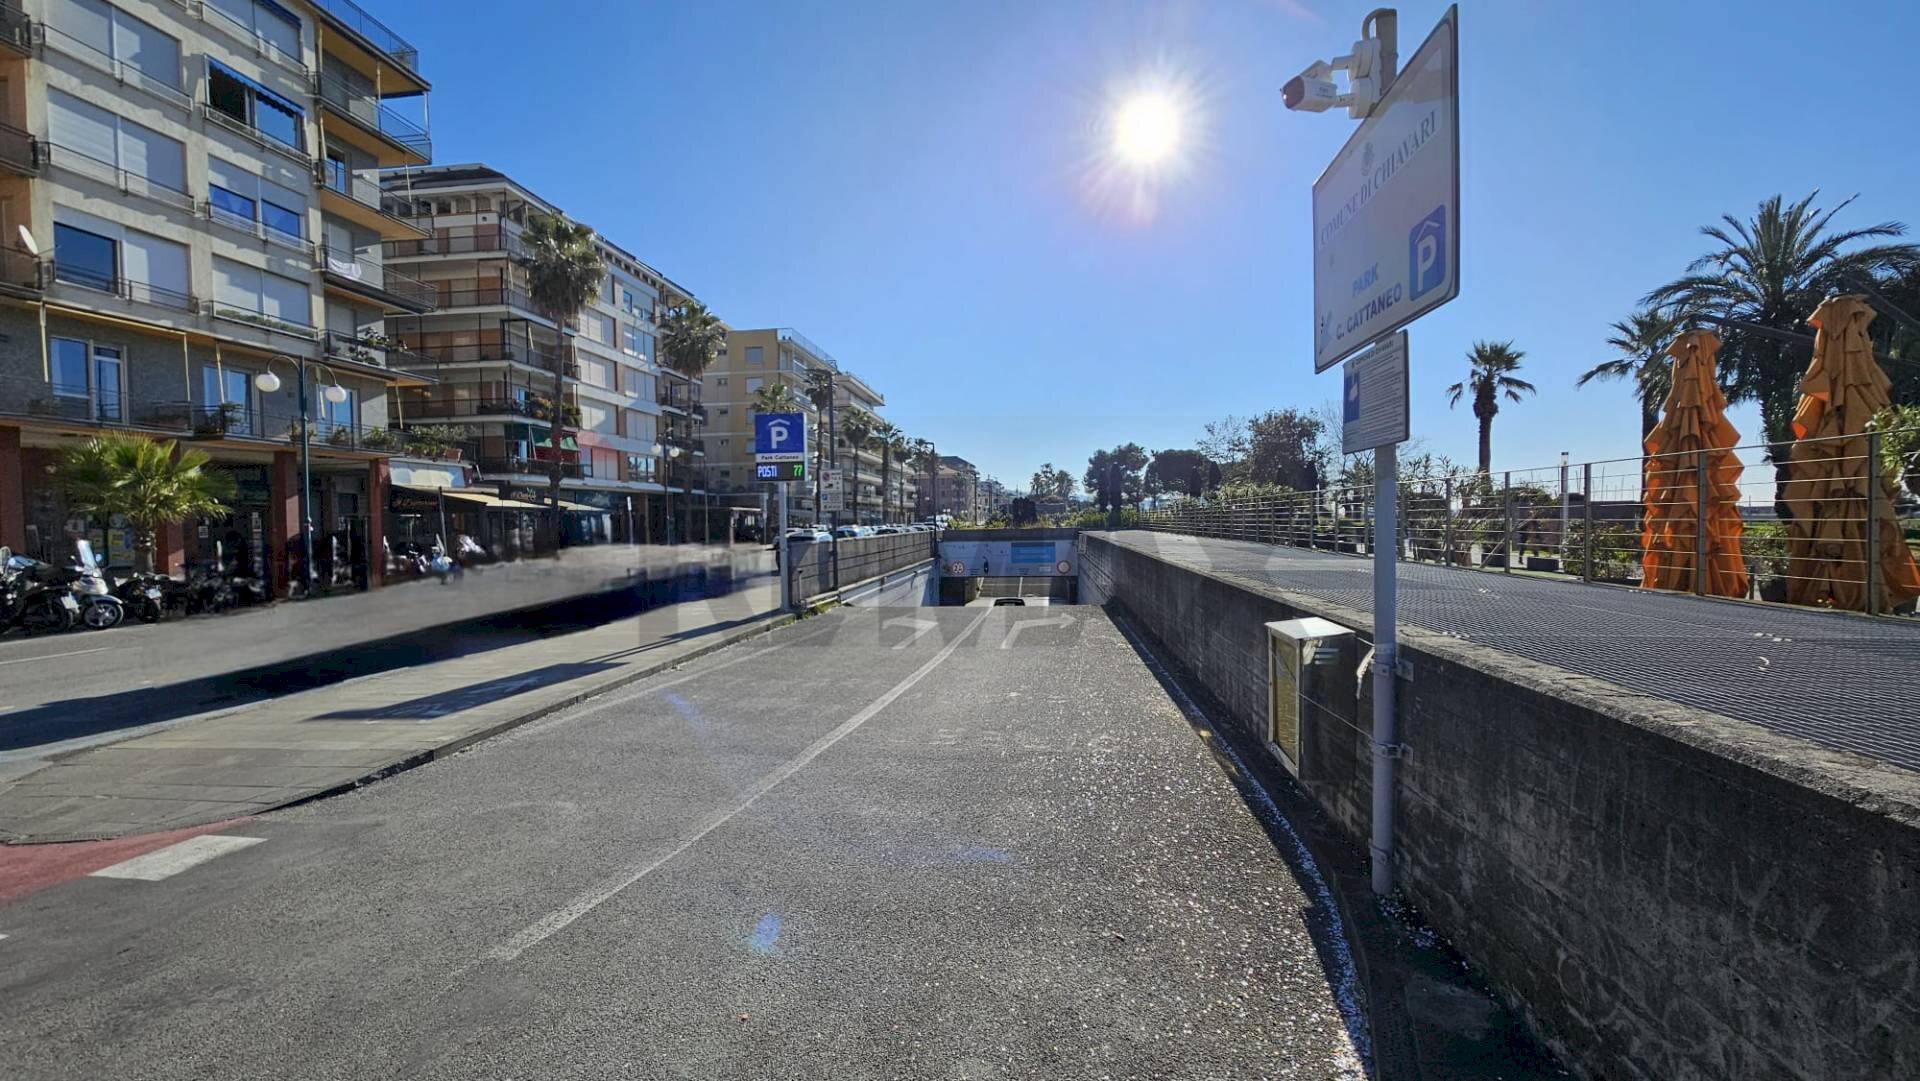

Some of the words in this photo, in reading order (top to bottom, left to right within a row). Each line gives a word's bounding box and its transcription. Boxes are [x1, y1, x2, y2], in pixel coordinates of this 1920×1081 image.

[1360, 178, 1372, 206] DI
[1373, 110, 1436, 190] CHIAVARI
[1352, 262, 1379, 297] PARK
[1417, 234, 1437, 292] P
[1347, 283, 1403, 332] CATTANEO
[771, 426, 788, 449] P
[757, 465, 778, 478] POSTI
[793, 464, 803, 477] 77
